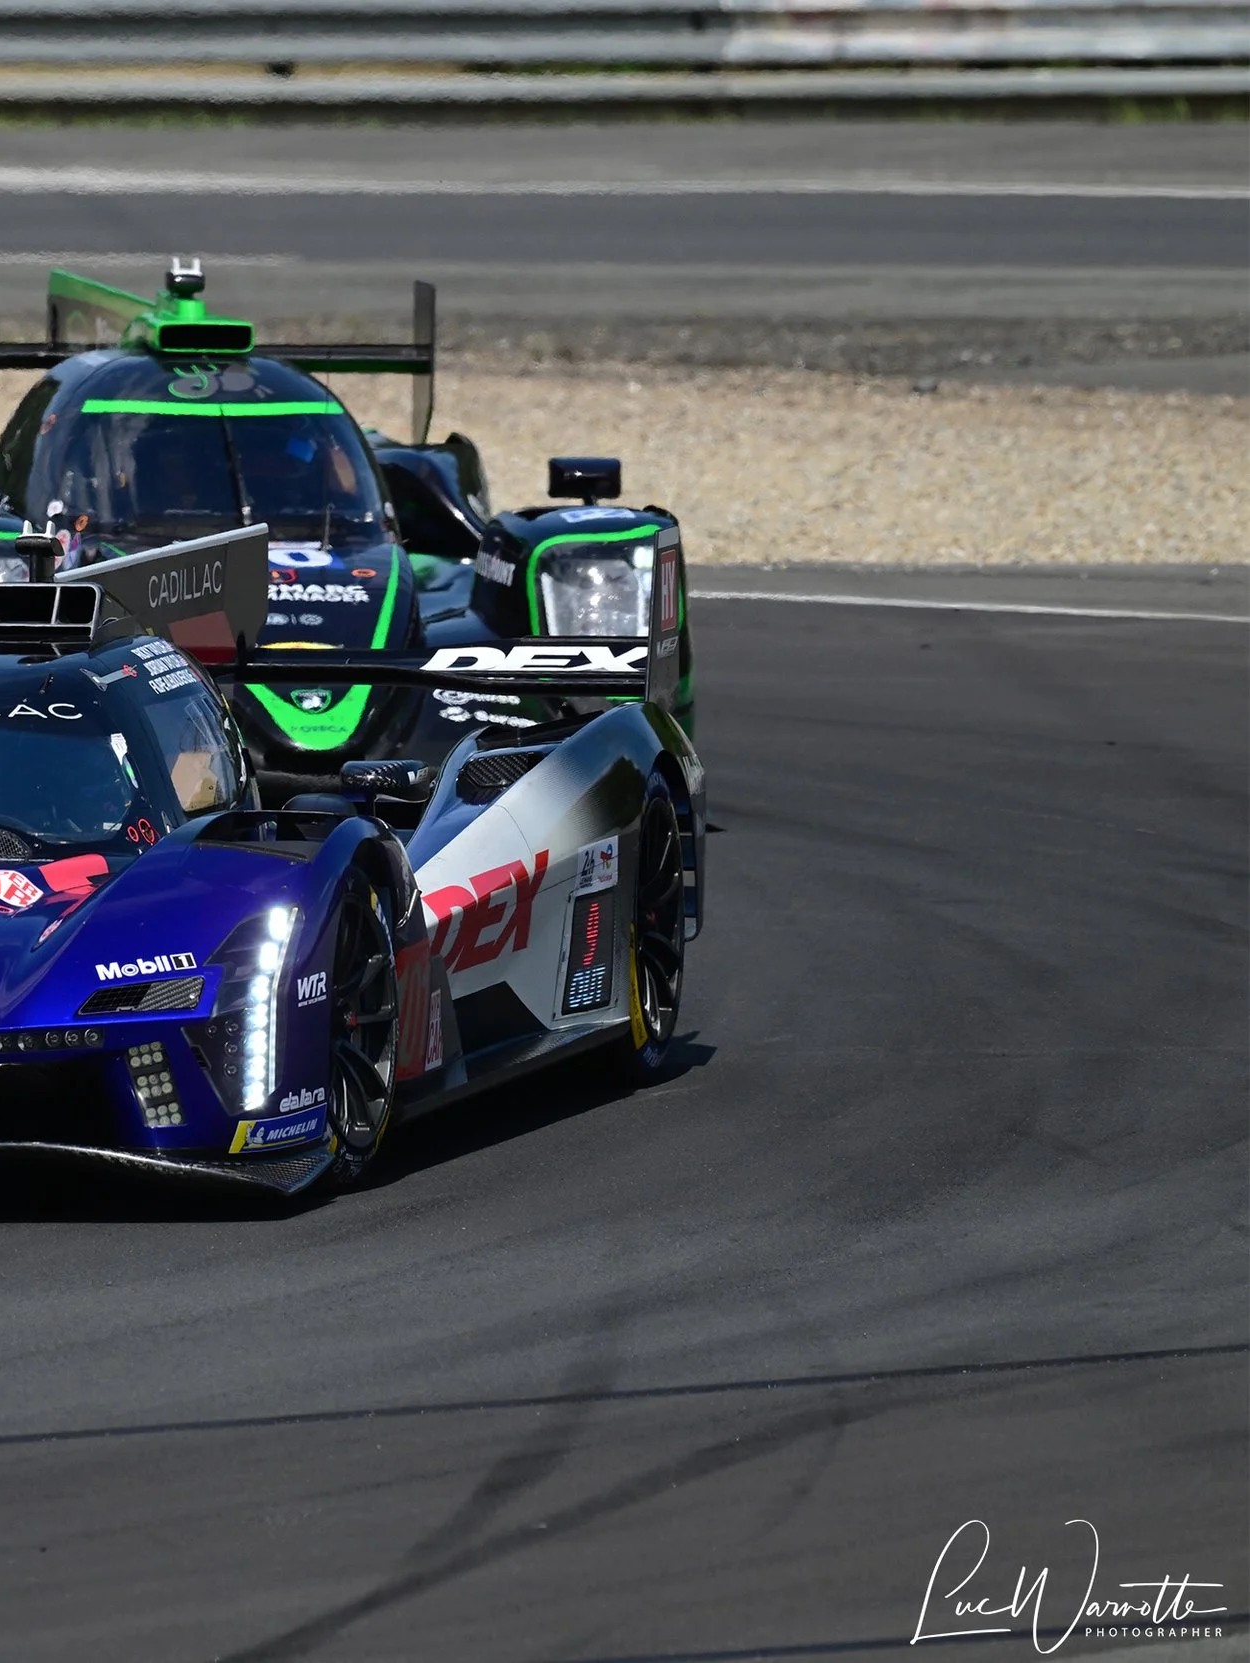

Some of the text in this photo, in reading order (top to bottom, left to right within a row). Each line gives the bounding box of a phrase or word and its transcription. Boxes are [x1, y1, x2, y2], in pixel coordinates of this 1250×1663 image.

[148, 561, 222, 608] CADILLAC
[419, 646, 648, 672] DEX
[95, 955, 171, 981] Mobil
[297, 971, 327, 1000] WTR
[266, 1117, 318, 1141] MICHELIN
